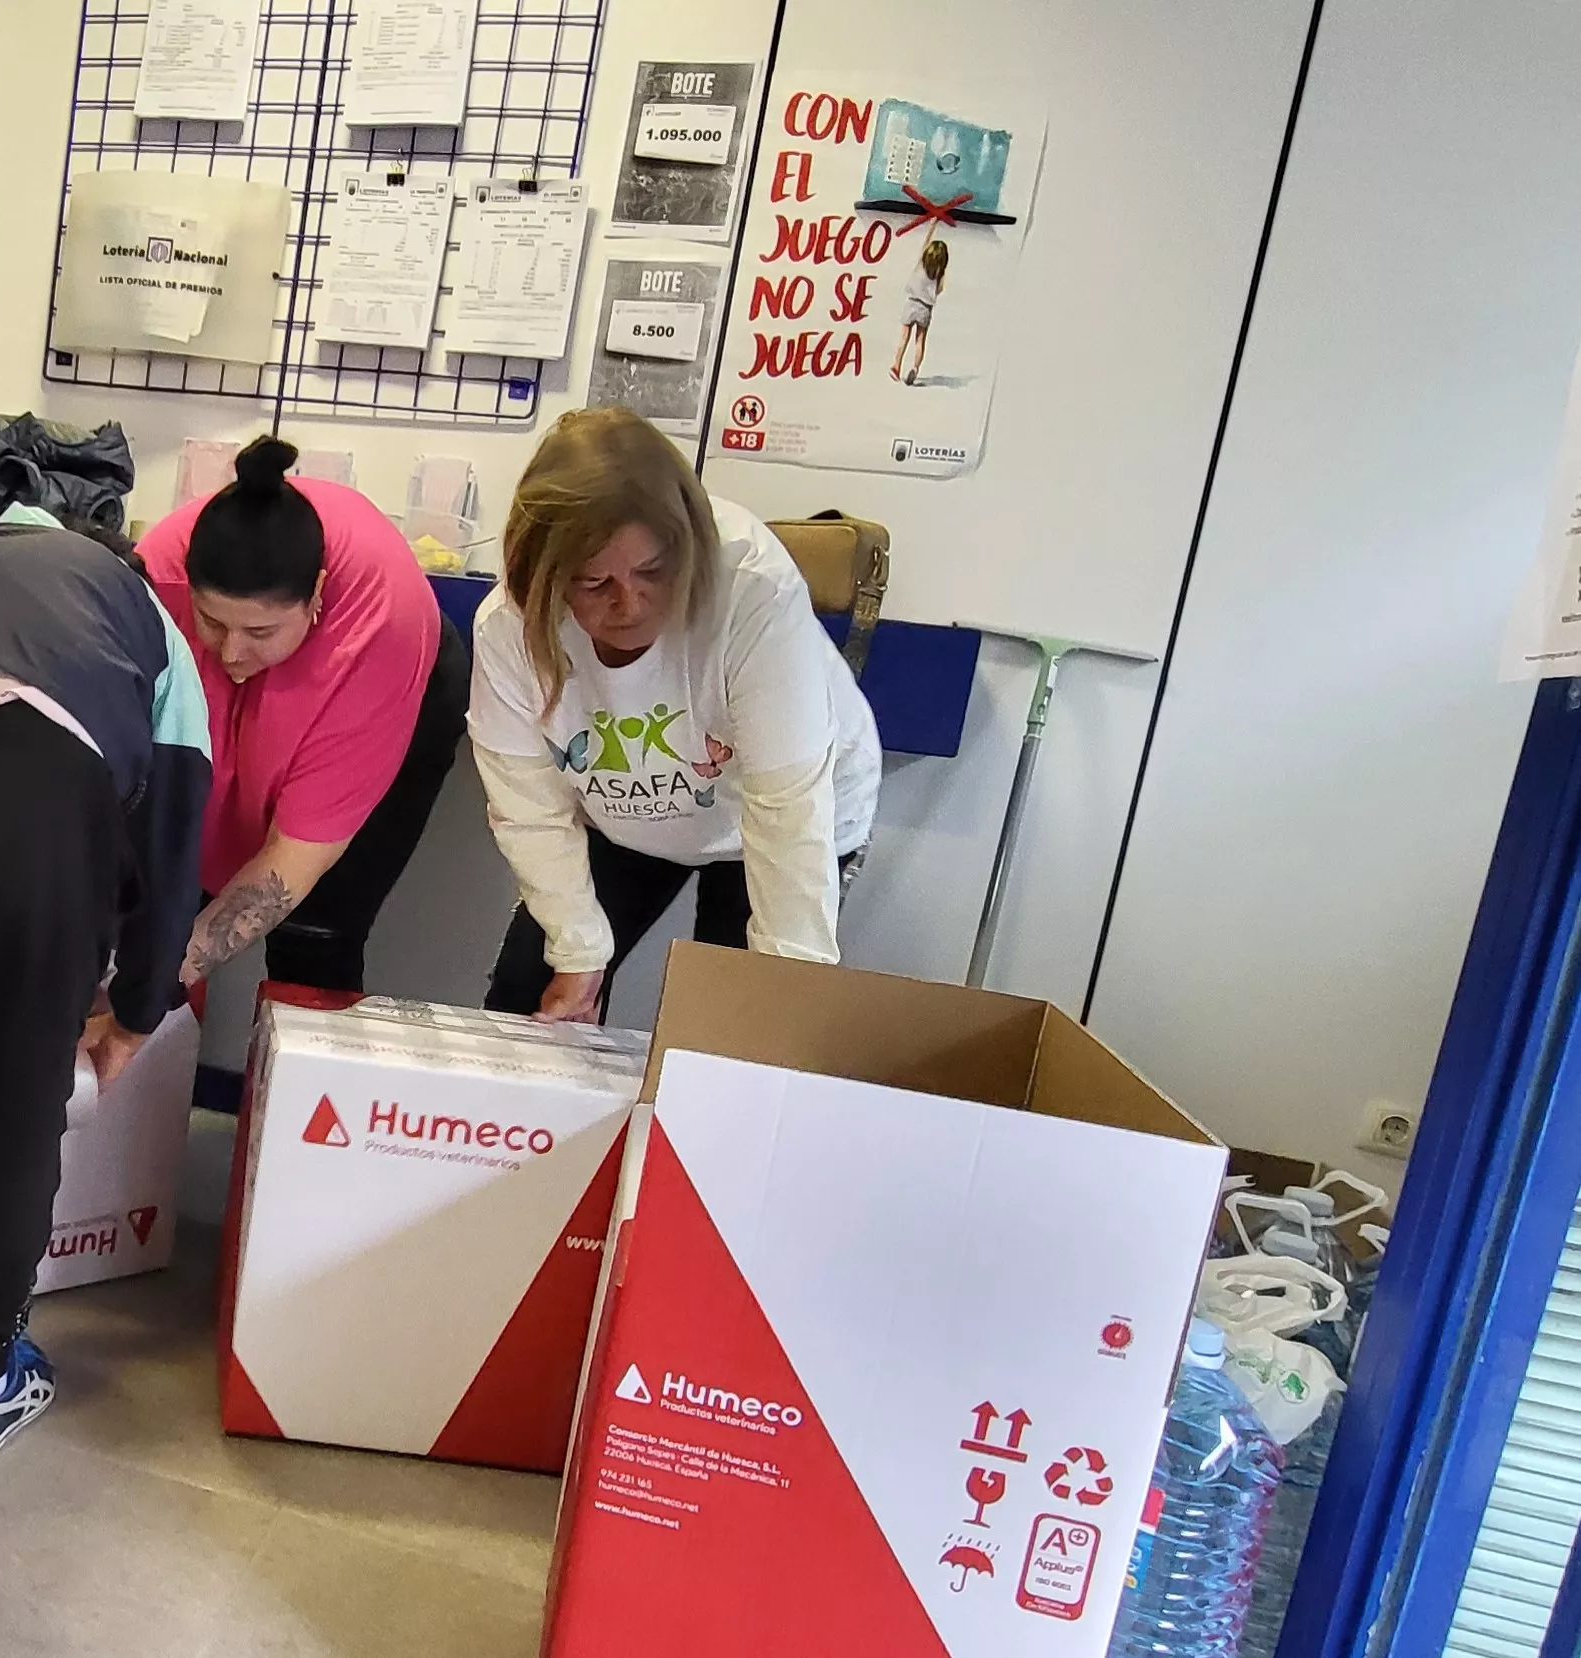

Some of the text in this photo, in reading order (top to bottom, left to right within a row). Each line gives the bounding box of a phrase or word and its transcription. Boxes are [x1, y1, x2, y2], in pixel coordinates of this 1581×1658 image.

[671, 72, 716, 95] BOTE
[784, 92, 874, 144] CON
[646, 128, 722, 142] 1.095.000
[770, 151, 818, 203] EL
[758, 214, 893, 264] JUEGO
[173, 248, 229, 267] Nacional
[99, 276, 223, 296] LISTA OFICIAL DE PREMIOS
[640, 270, 684, 293] BOTE
[748, 273, 878, 323] NO SE
[632, 324, 675, 338] 8.500
[738, 331, 863, 380] JUEGA
[586, 770, 693, 800] ASAFA
[604, 800, 680, 816] HUESCA
[368, 1099, 554, 1154] Humeco
[364, 1138, 521, 1172] Productos veterinarios
[48, 1227, 118, 1259] Hum
[662, 1371, 802, 1427] Humeco
[660, 1398, 777, 1436] Productos veterinarios
[594, 1500, 680, 1530] www.humeco.net
